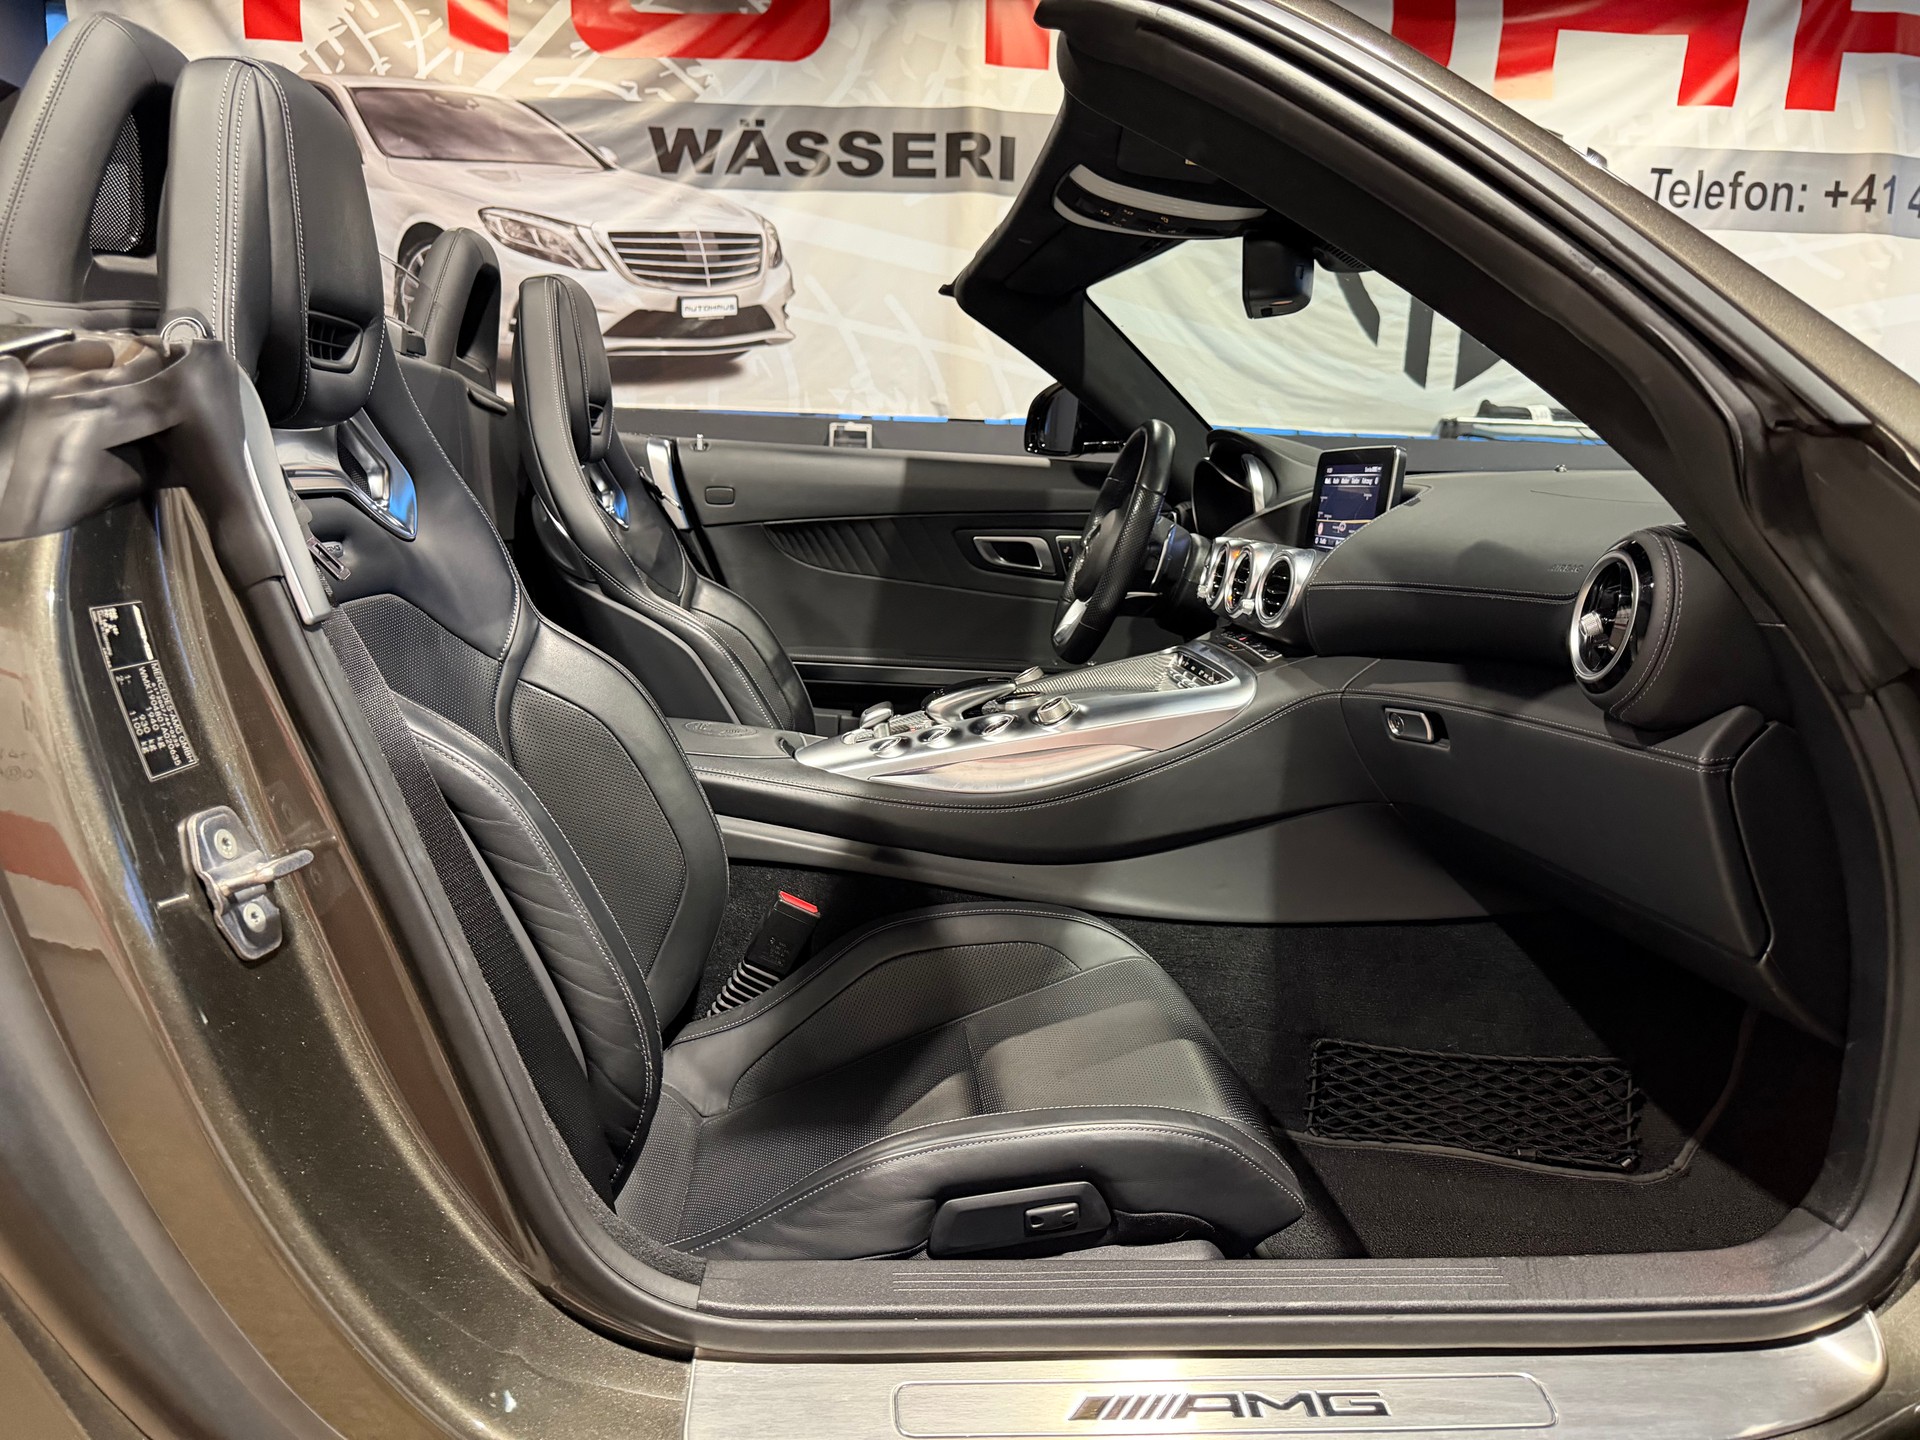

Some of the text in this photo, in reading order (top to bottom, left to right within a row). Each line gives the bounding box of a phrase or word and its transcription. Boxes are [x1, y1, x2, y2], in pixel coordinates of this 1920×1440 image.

[648, 119, 1016, 182] WÄSSERI
[1650, 167, 1807, 213] Telefon:
[1824, 173, 1896, 215] +41
[129, 710, 144, 737] 1100
[139, 714, 151, 734] 930
[145, 706, 160, 731] 1940
[1171, 1390, 1392, 1419] AMG
